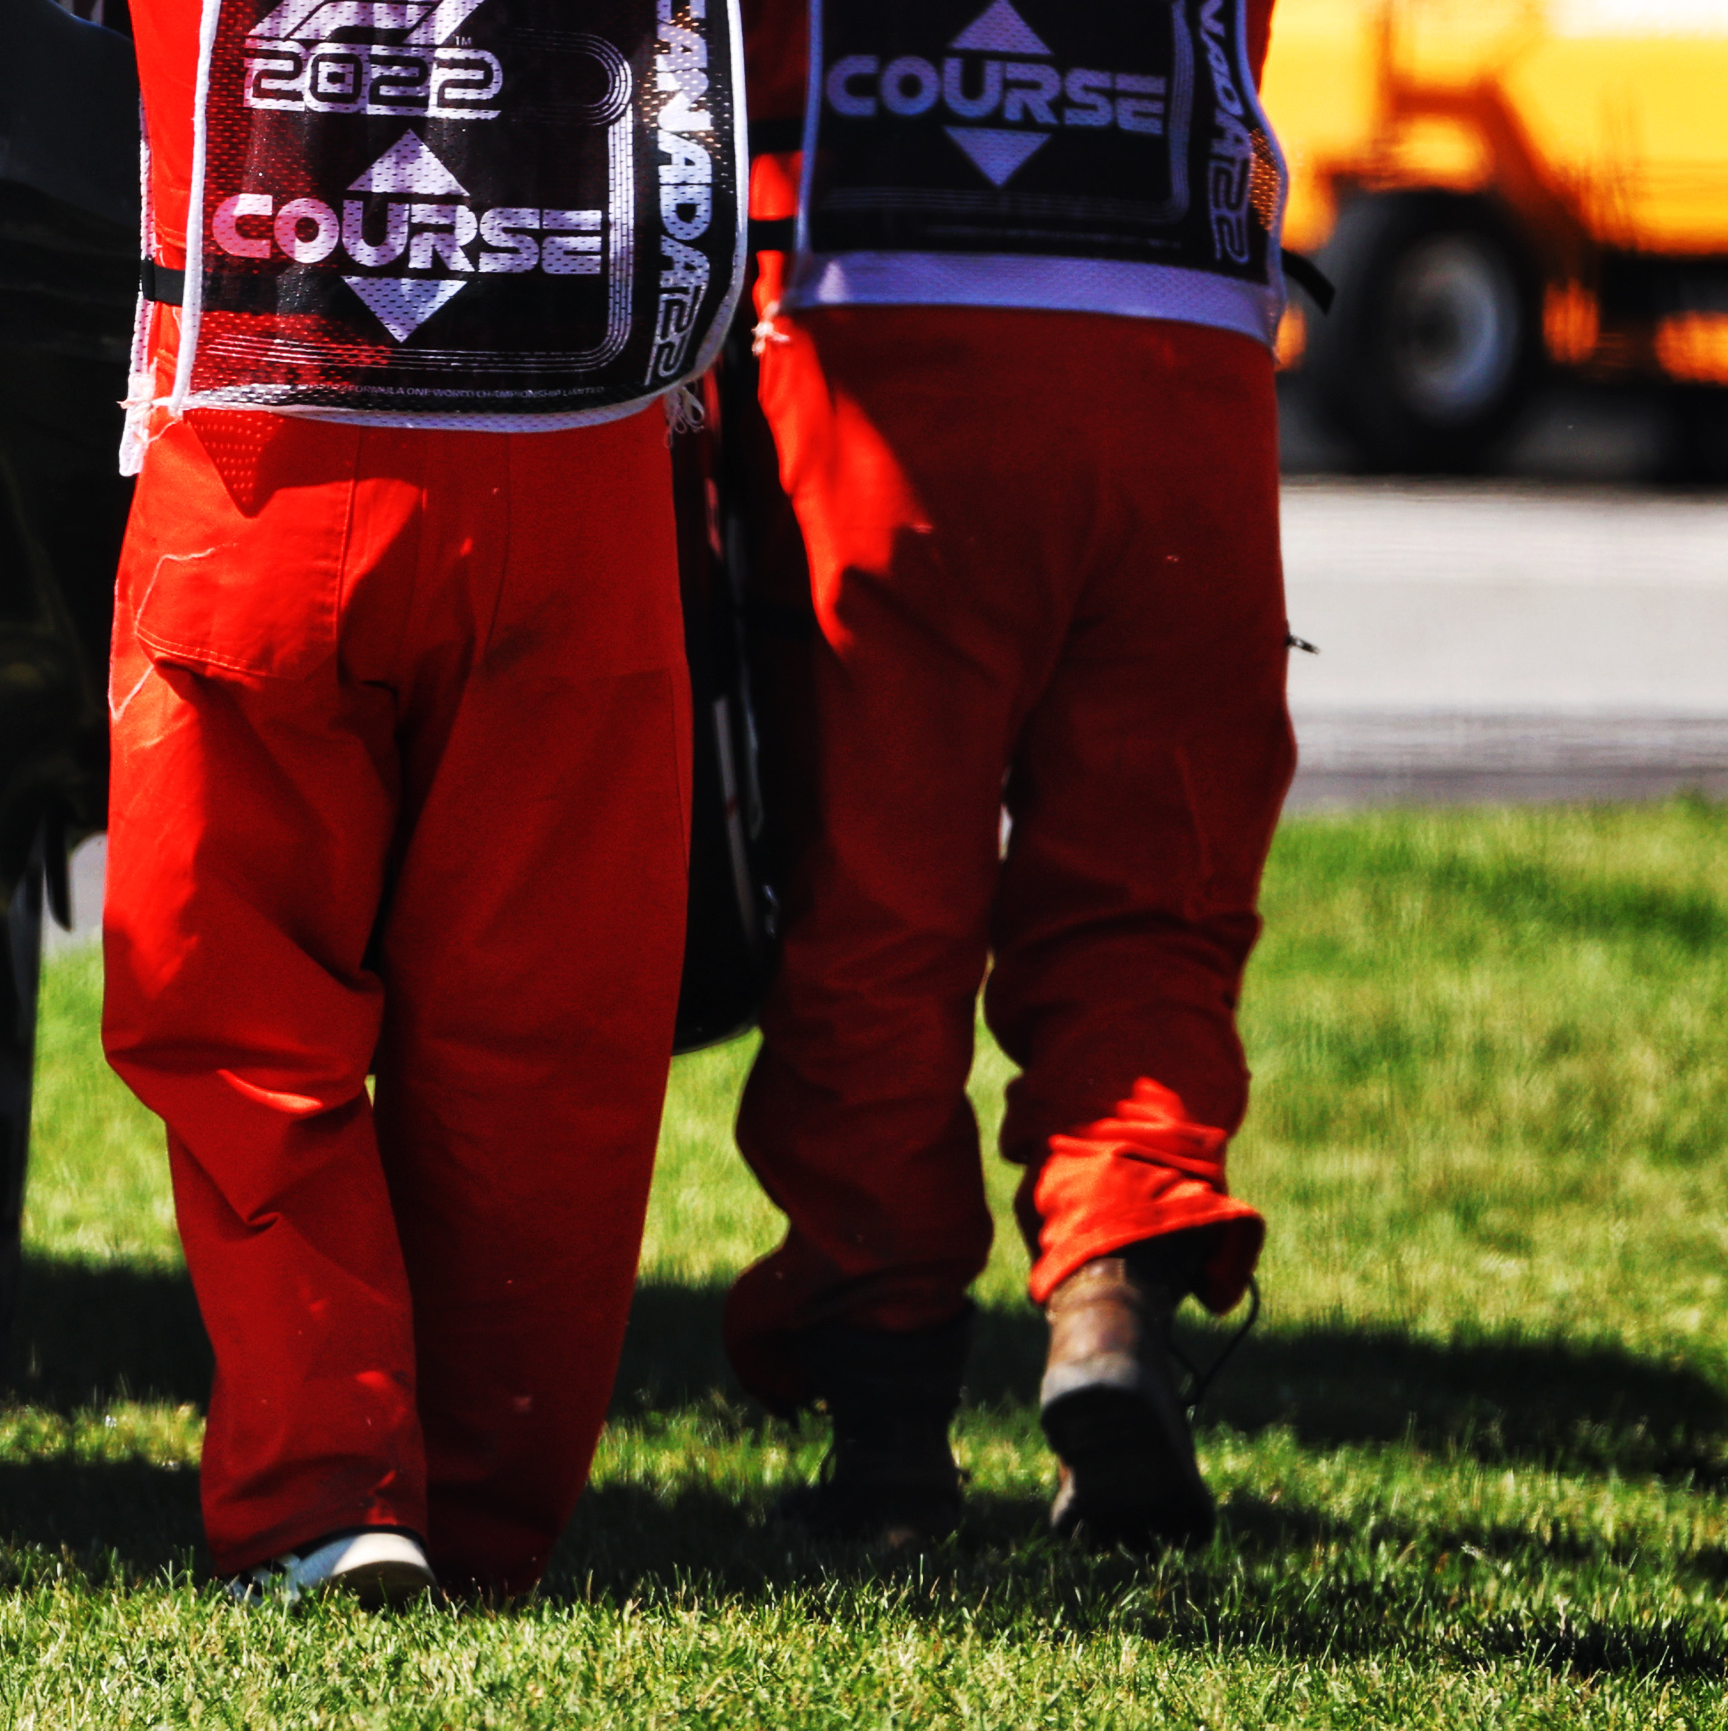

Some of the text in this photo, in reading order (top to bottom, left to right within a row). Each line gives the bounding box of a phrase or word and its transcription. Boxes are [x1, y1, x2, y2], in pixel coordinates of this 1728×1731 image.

[243, 39, 504, 121] 2022
[826, 54, 1166, 135] COURSE
[212, 192, 603, 276] COURSE
